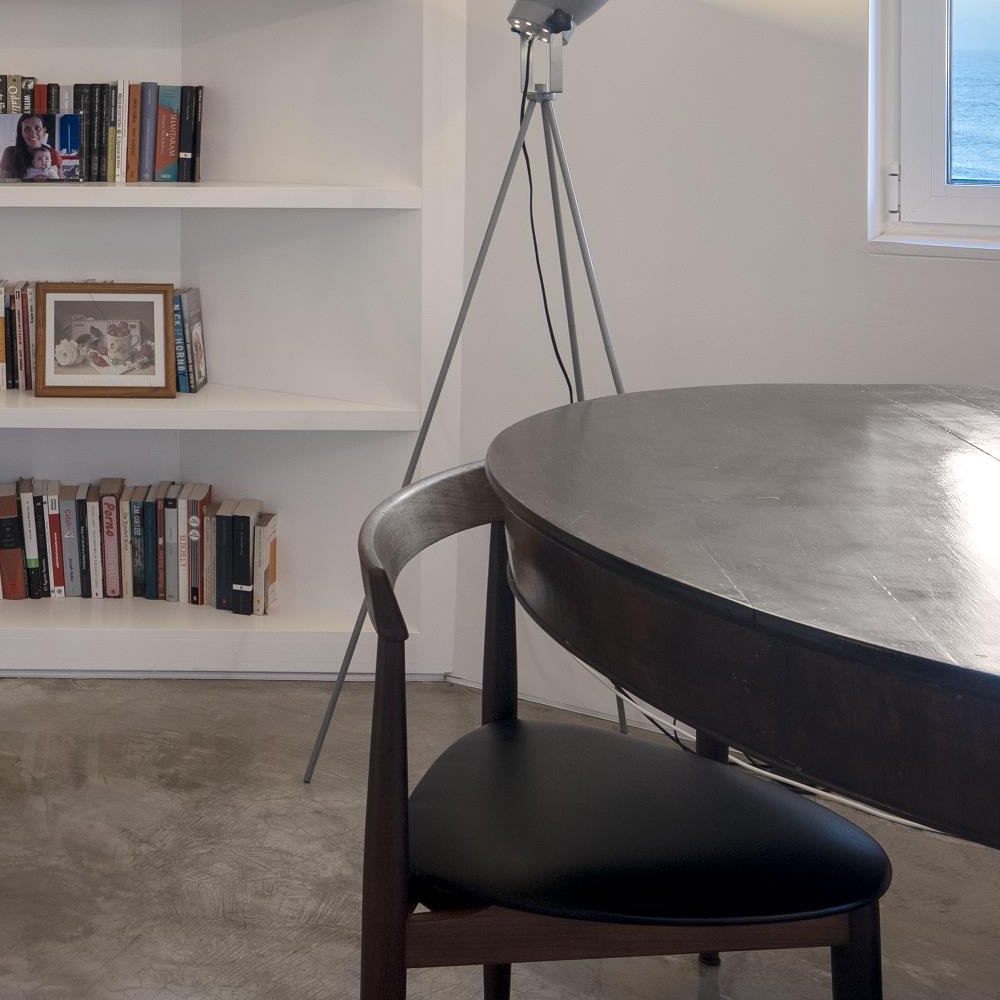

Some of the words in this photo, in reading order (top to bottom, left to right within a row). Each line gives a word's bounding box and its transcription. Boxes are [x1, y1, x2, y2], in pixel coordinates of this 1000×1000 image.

[168, 114, 176, 157] SHANTARAM
[175, 338, 186, 377] HORNBY
[104, 502, 115, 537] Porno
